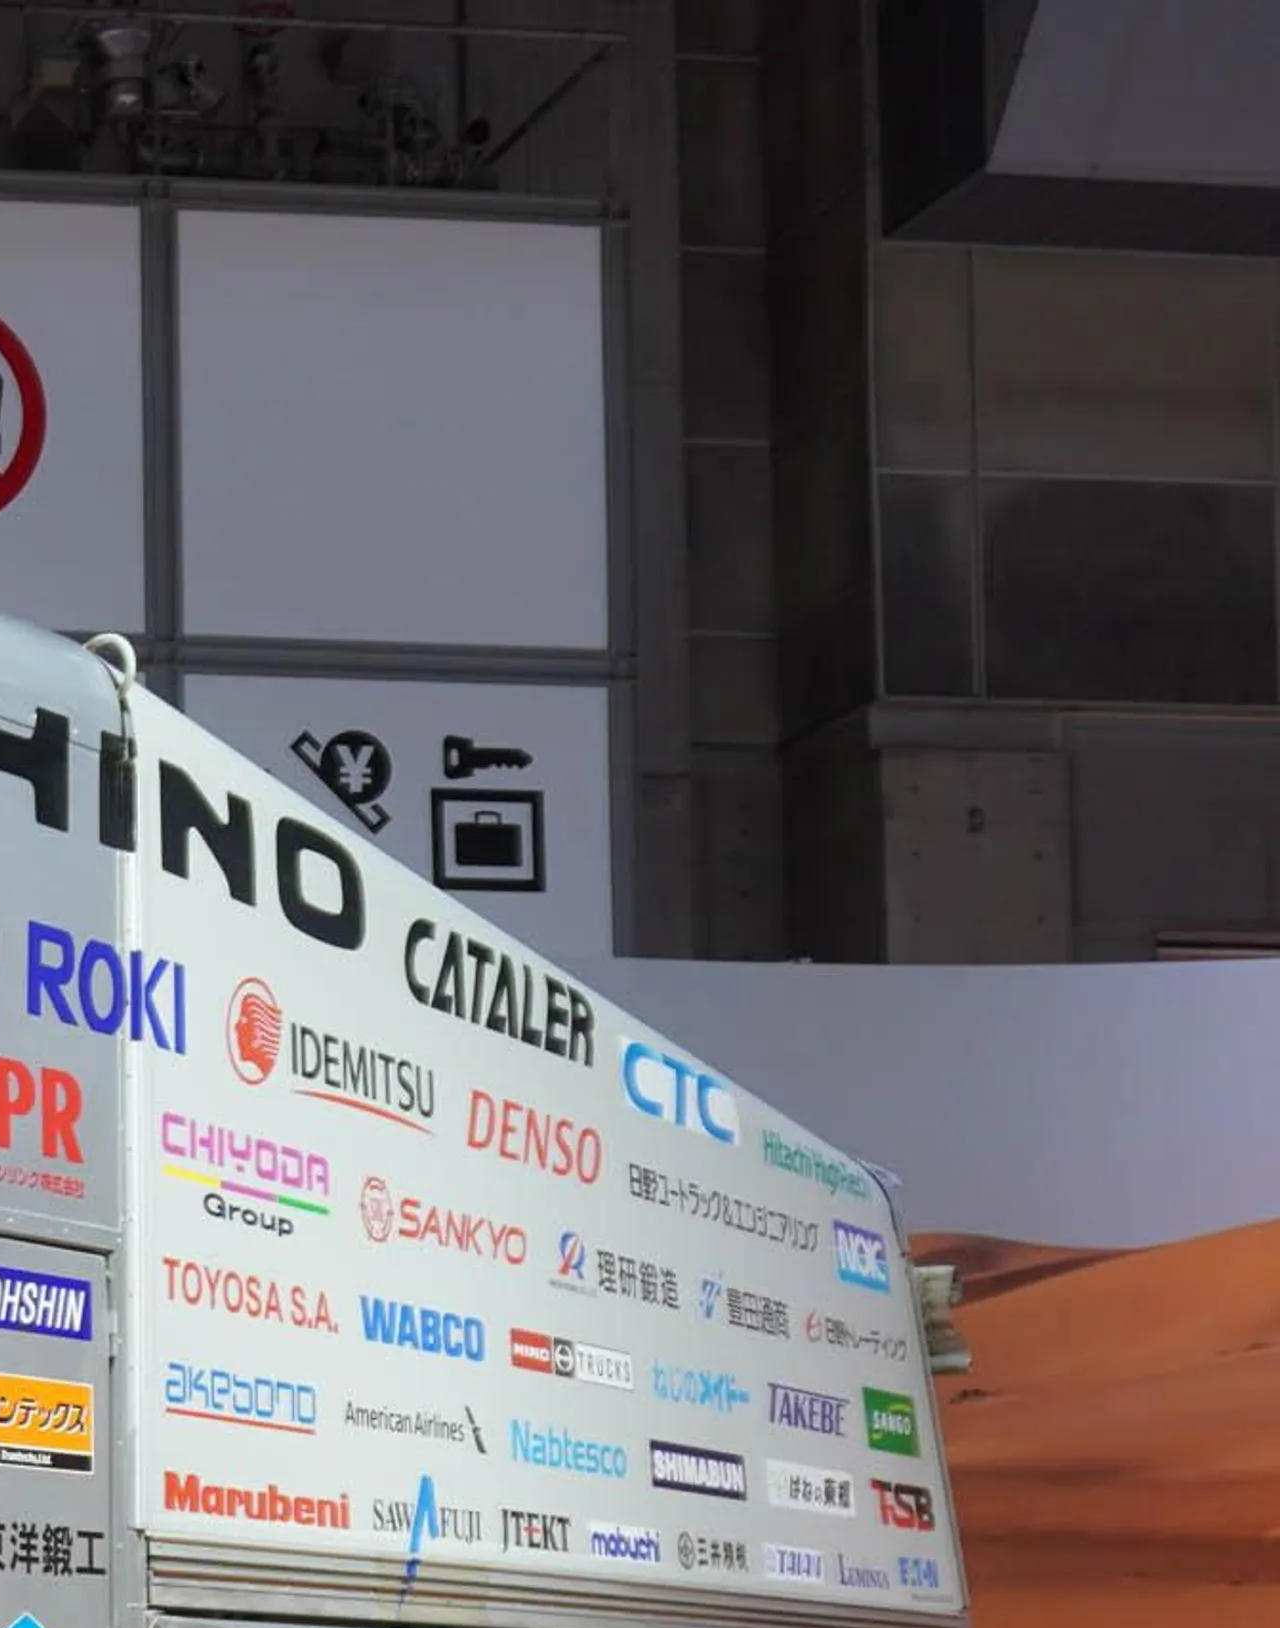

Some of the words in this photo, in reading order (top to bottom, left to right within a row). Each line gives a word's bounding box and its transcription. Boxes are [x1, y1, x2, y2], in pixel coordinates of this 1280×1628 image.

[27, 920, 186, 1055] ROKI
[404, 918, 595, 1067] CATALER
[290, 1021, 436, 1121] IDEMITSU
[620, 1040, 737, 1144] CTC
[161, 1112, 330, 1196] CHIYODA
[466, 1089, 602, 1185] DENSO
[203, 1193, 295, 1237] Group
[398, 1196, 528, 1266] SANKYO
[162, 1255, 284, 1322] TOYOSA
[291, 1284, 340, 1335] S.A.
[359, 1294, 486, 1363] WABCO
[164, 1363, 318, 1424] akebono
[577, 1350, 633, 1383] TRUCKS
[344, 1401, 414, 1437] American
[414, 1414, 466, 1445] Airlines
[767, 1382, 851, 1438] TAKEBE
[510, 1418, 628, 1479] Nabtesco
[653, 1447, 747, 1496] SHIMABUN
[164, 1470, 350, 1530] Marubeni
[868, 1477, 936, 1532] TSB
[501, 1508, 571, 1554] JTEKT
[590, 1528, 661, 1564] mabuchi
